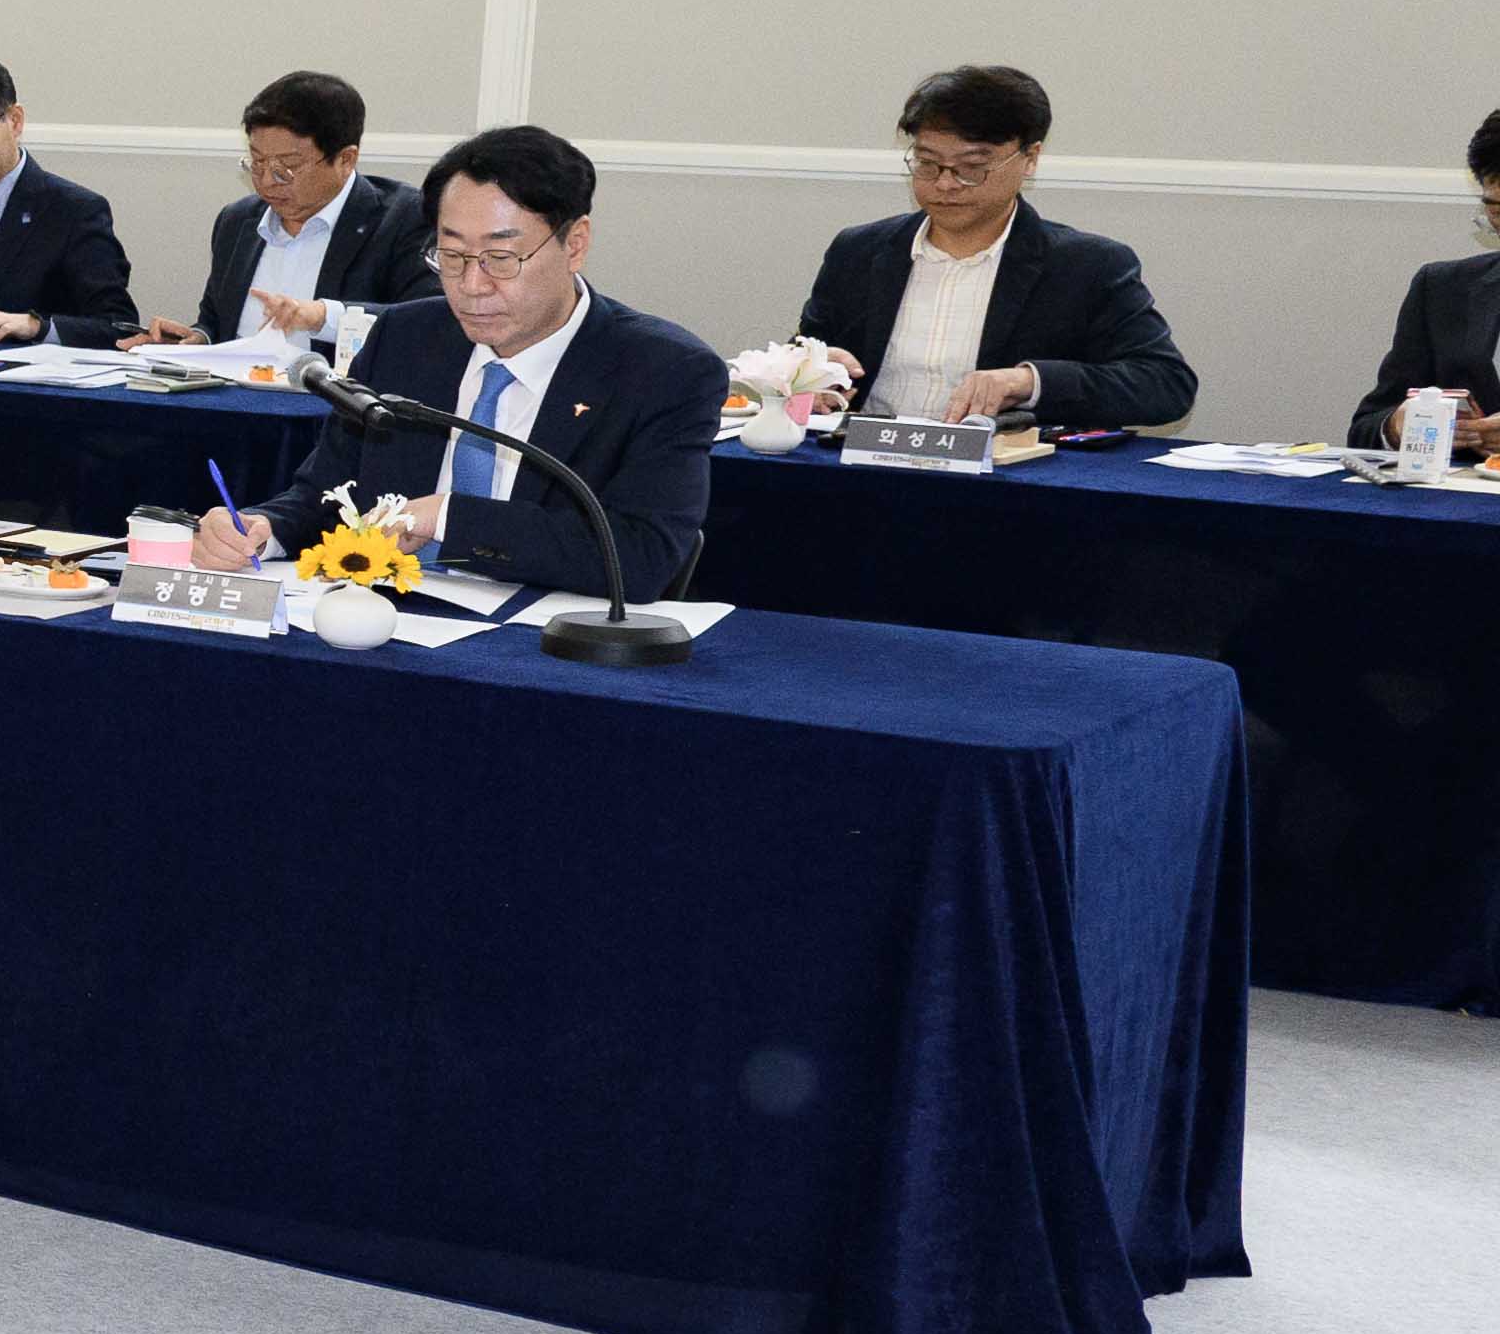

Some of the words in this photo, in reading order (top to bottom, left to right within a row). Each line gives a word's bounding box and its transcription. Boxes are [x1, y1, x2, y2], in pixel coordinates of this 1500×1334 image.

[878, 428, 956, 450] 화성시
[1405, 442, 1436, 455] WATER
[155, 581, 243, 611] 정명근
